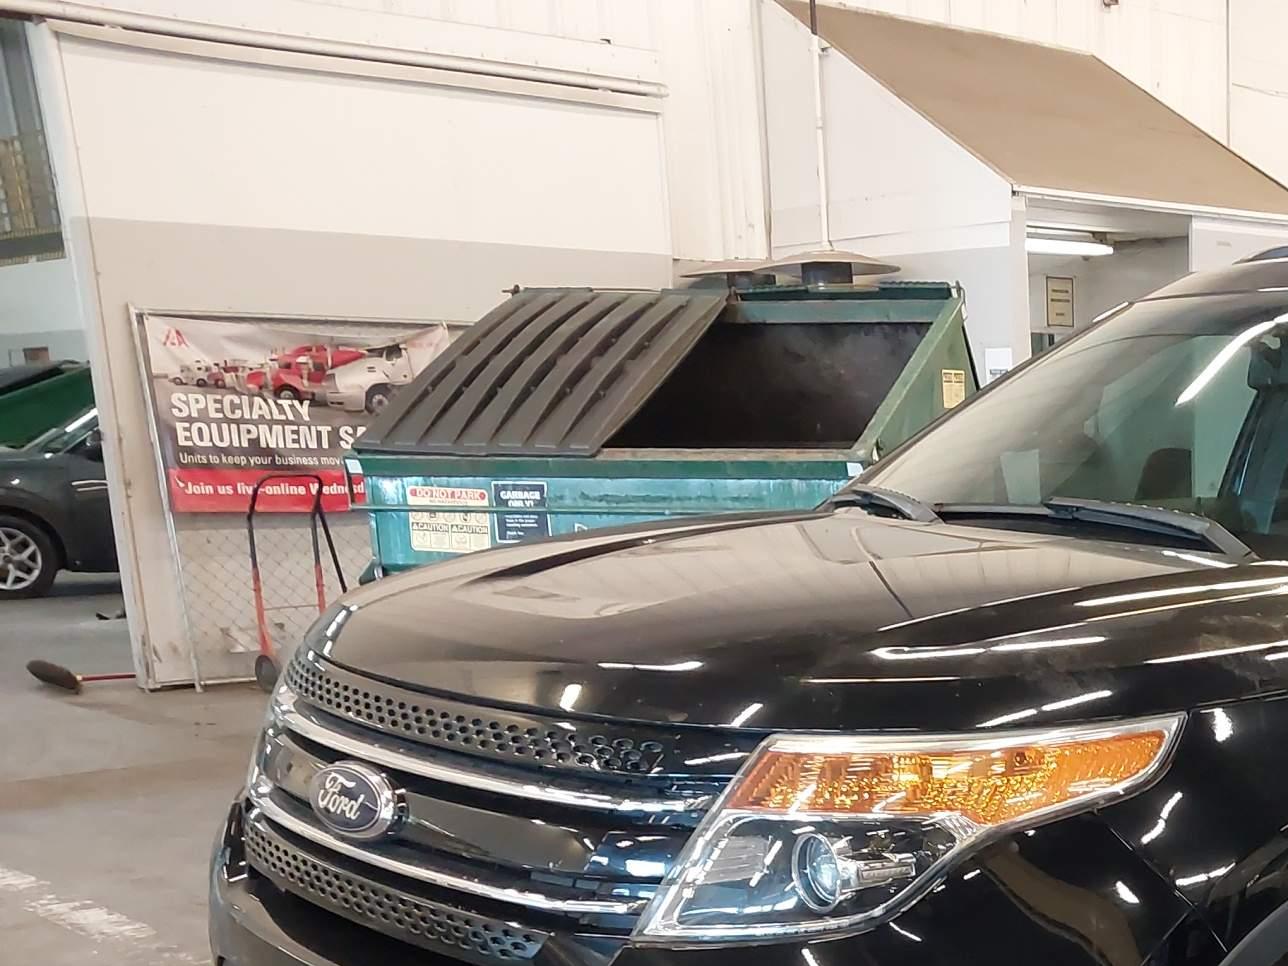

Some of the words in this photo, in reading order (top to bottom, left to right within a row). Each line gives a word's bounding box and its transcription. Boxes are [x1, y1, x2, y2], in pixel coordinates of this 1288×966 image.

[170, 392, 311, 421] SPECIALTY
[175, 422, 332, 449] EQUIPMENT
[179, 451, 207, 464] Units
[209, 452, 220, 464] to
[221, 453, 247, 466] keep
[249, 455, 272, 467] your
[274, 454, 319, 466] business
[184, 481, 213, 495] Join
[216, 484, 233, 495] us
[236, 481, 307, 496] liv-online
[417, 488, 431, 497] DO
[432, 489, 452, 499] NOT
[454, 490, 480, 500] PARK
[500, 491, 540, 500] GARBAGE
[420, 523, 449, 532] CAUTION
[458, 525, 488, 534] CAUTION
[318, 771, 366, 820] Ford
